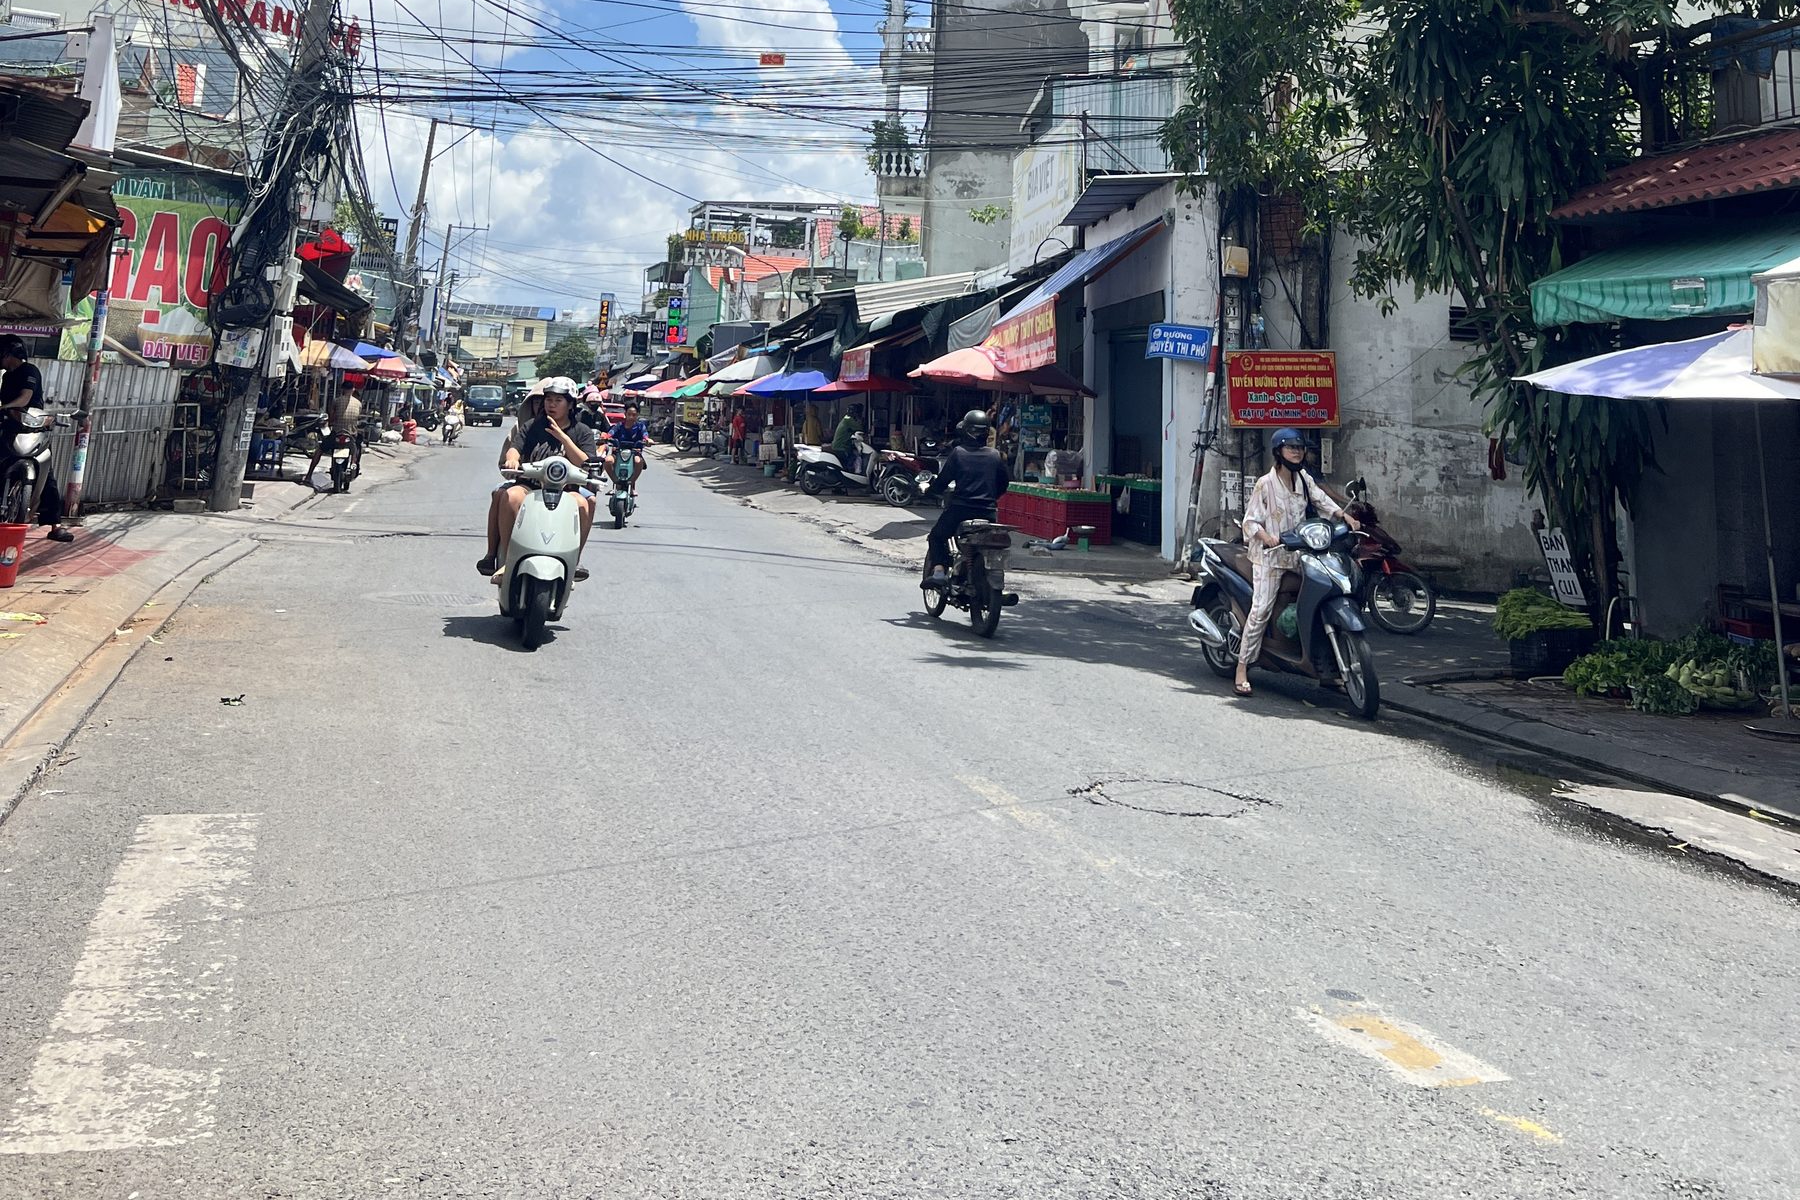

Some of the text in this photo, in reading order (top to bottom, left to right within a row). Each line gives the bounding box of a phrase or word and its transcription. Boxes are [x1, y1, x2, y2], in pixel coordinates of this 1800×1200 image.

[130, 176, 166, 200] VÂN
[682, 242, 706, 266] LÊ
[1163, 331, 1193, 340] ĐƯỜNG
[142, 336, 173, 359] ĐẤT
[176, 343, 210, 365] VIỆT
[1176, 342, 1189, 357] THỊ
[1231, 374, 1253, 388] TUYẾN
[1254, 374, 1278, 388] ĐƯỜNG
[1294, 373, 1315, 388] CHIẾN
[1316, 377, 1333, 388] BINH
[1248, 392, 1319, 405] Xanh Sạch Đẹp
[1283, 409, 1302, 418] MINH
